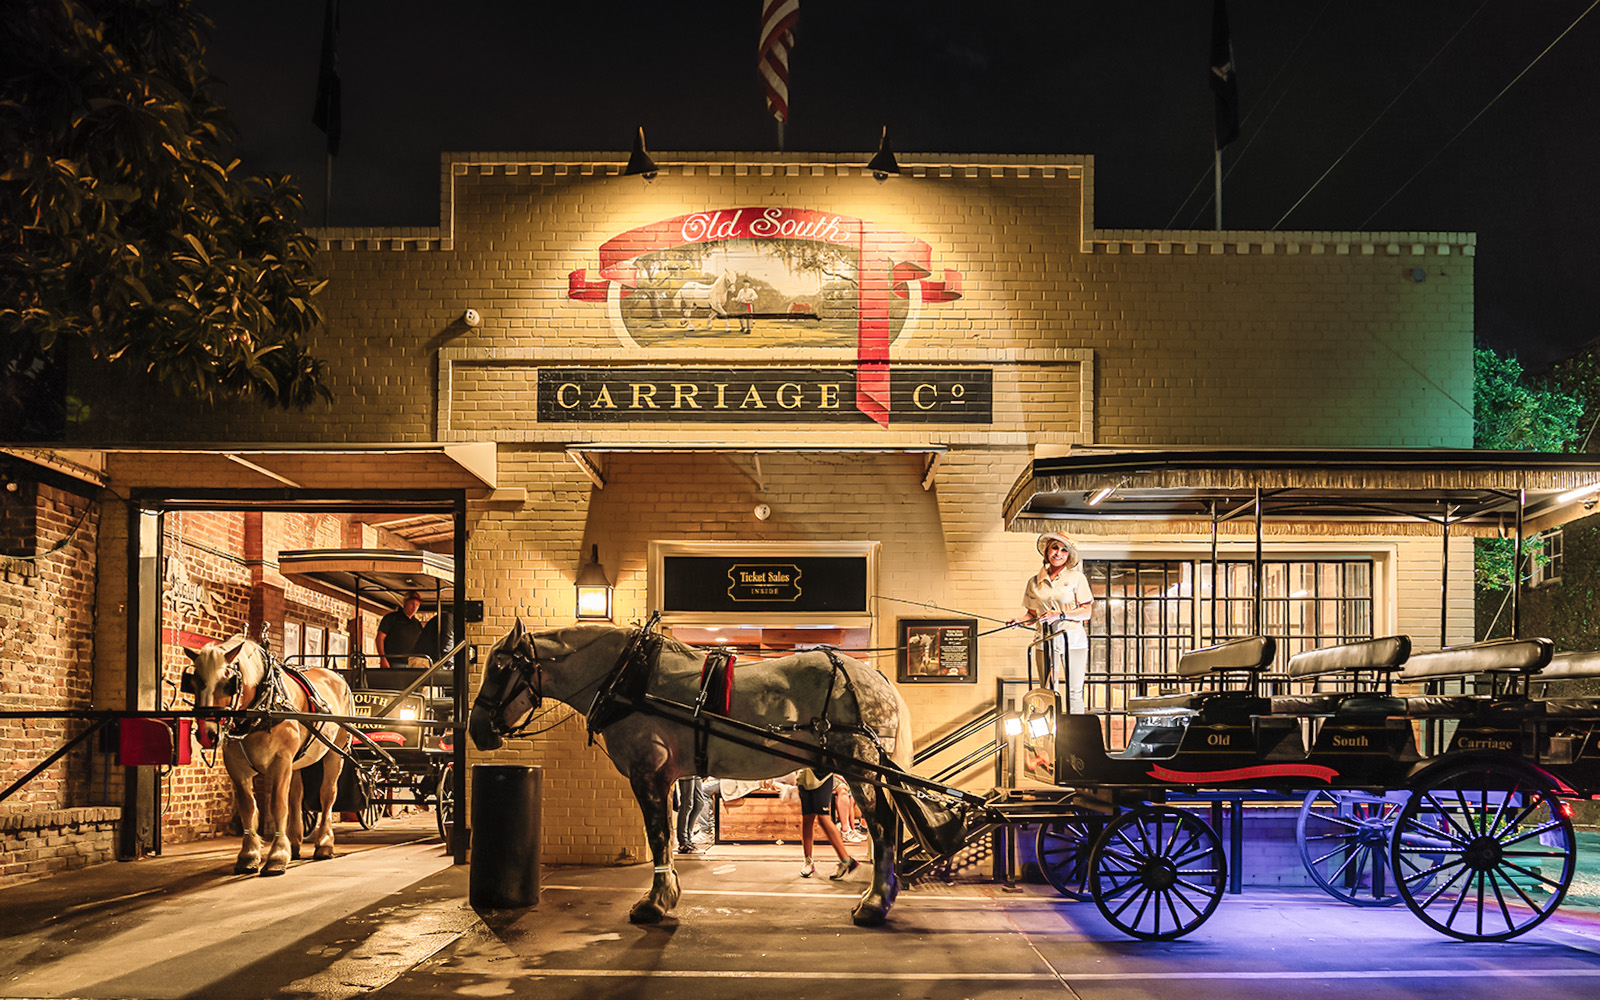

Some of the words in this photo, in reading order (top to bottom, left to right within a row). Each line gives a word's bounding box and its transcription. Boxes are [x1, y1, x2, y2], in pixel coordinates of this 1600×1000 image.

[681, 211, 742, 242] Old
[749, 207, 851, 243] South
[556, 382, 841, 410] CARRIAGE
[740, 571, 766, 583] Ticket
[768, 571, 790, 583] Sales
[352, 694, 388, 707] OUTH
[1206, 733, 1231, 747] Old
[1332, 733, 1369, 747] South
[1457, 736, 1513, 751] Carriage
